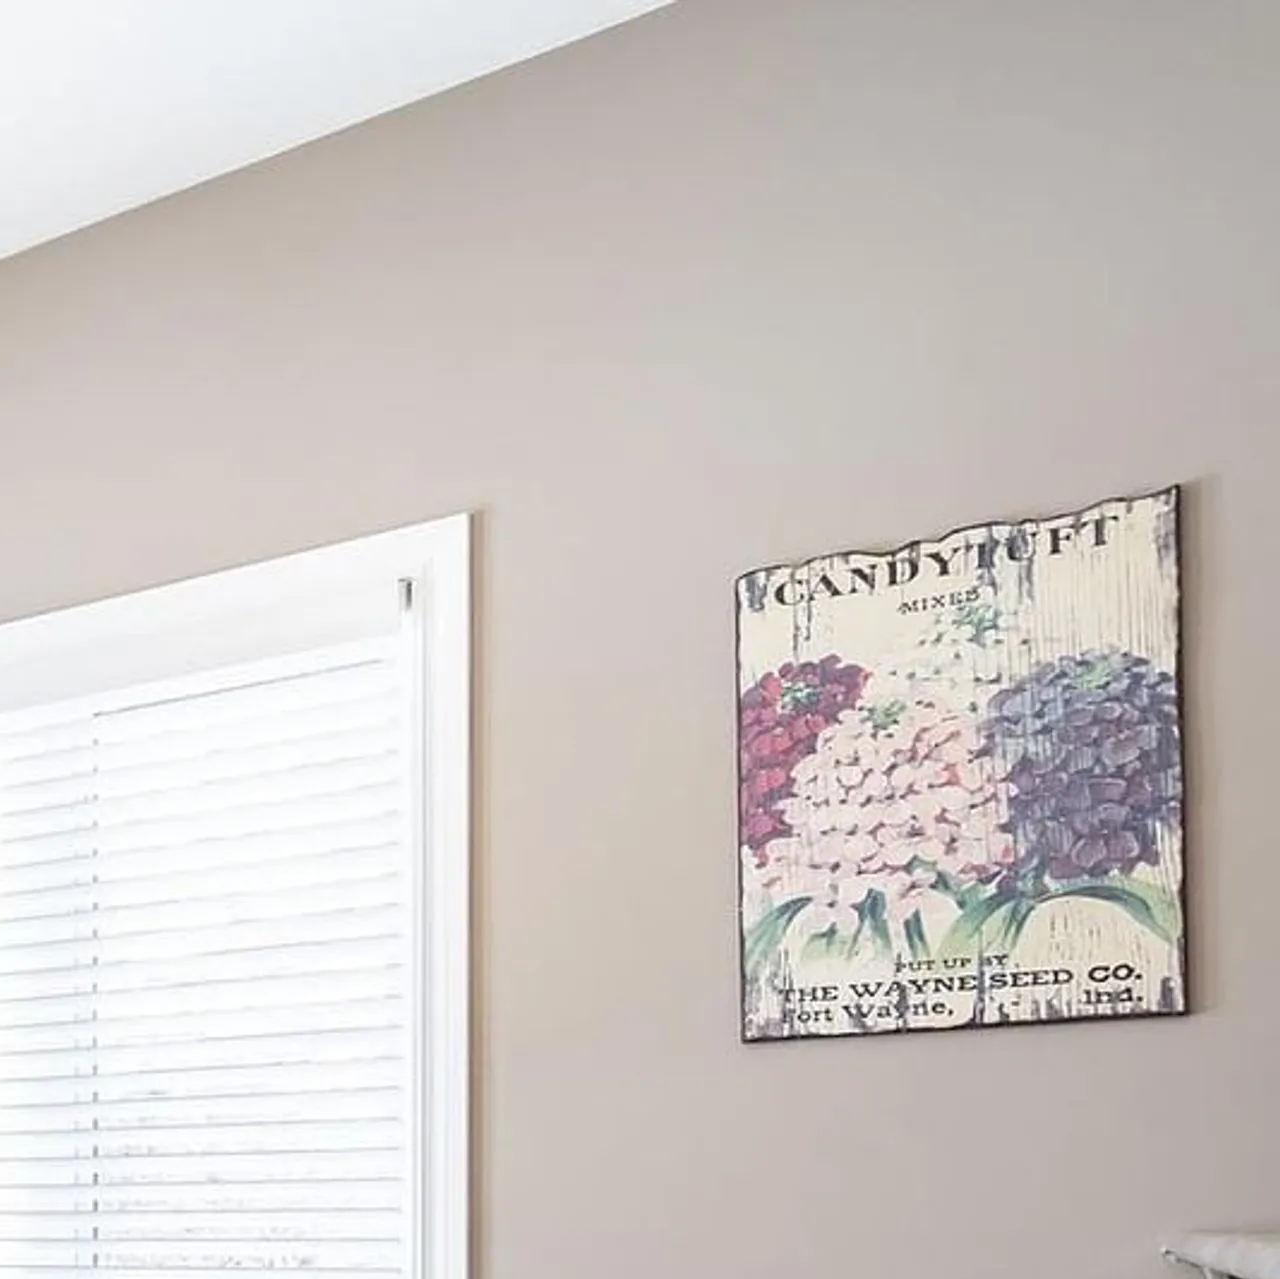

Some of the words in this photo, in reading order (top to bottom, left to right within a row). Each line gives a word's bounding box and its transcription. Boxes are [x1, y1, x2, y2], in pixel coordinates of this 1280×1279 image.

[774, 515, 1118, 606] CANDYTUFT
[778, 985, 839, 1003] THE
[849, 974, 978, 1000] WAYNE
[989, 968, 1074, 990] SEED
[1087, 963, 1144, 983] CO.
[943, 957, 972, 970] UP
